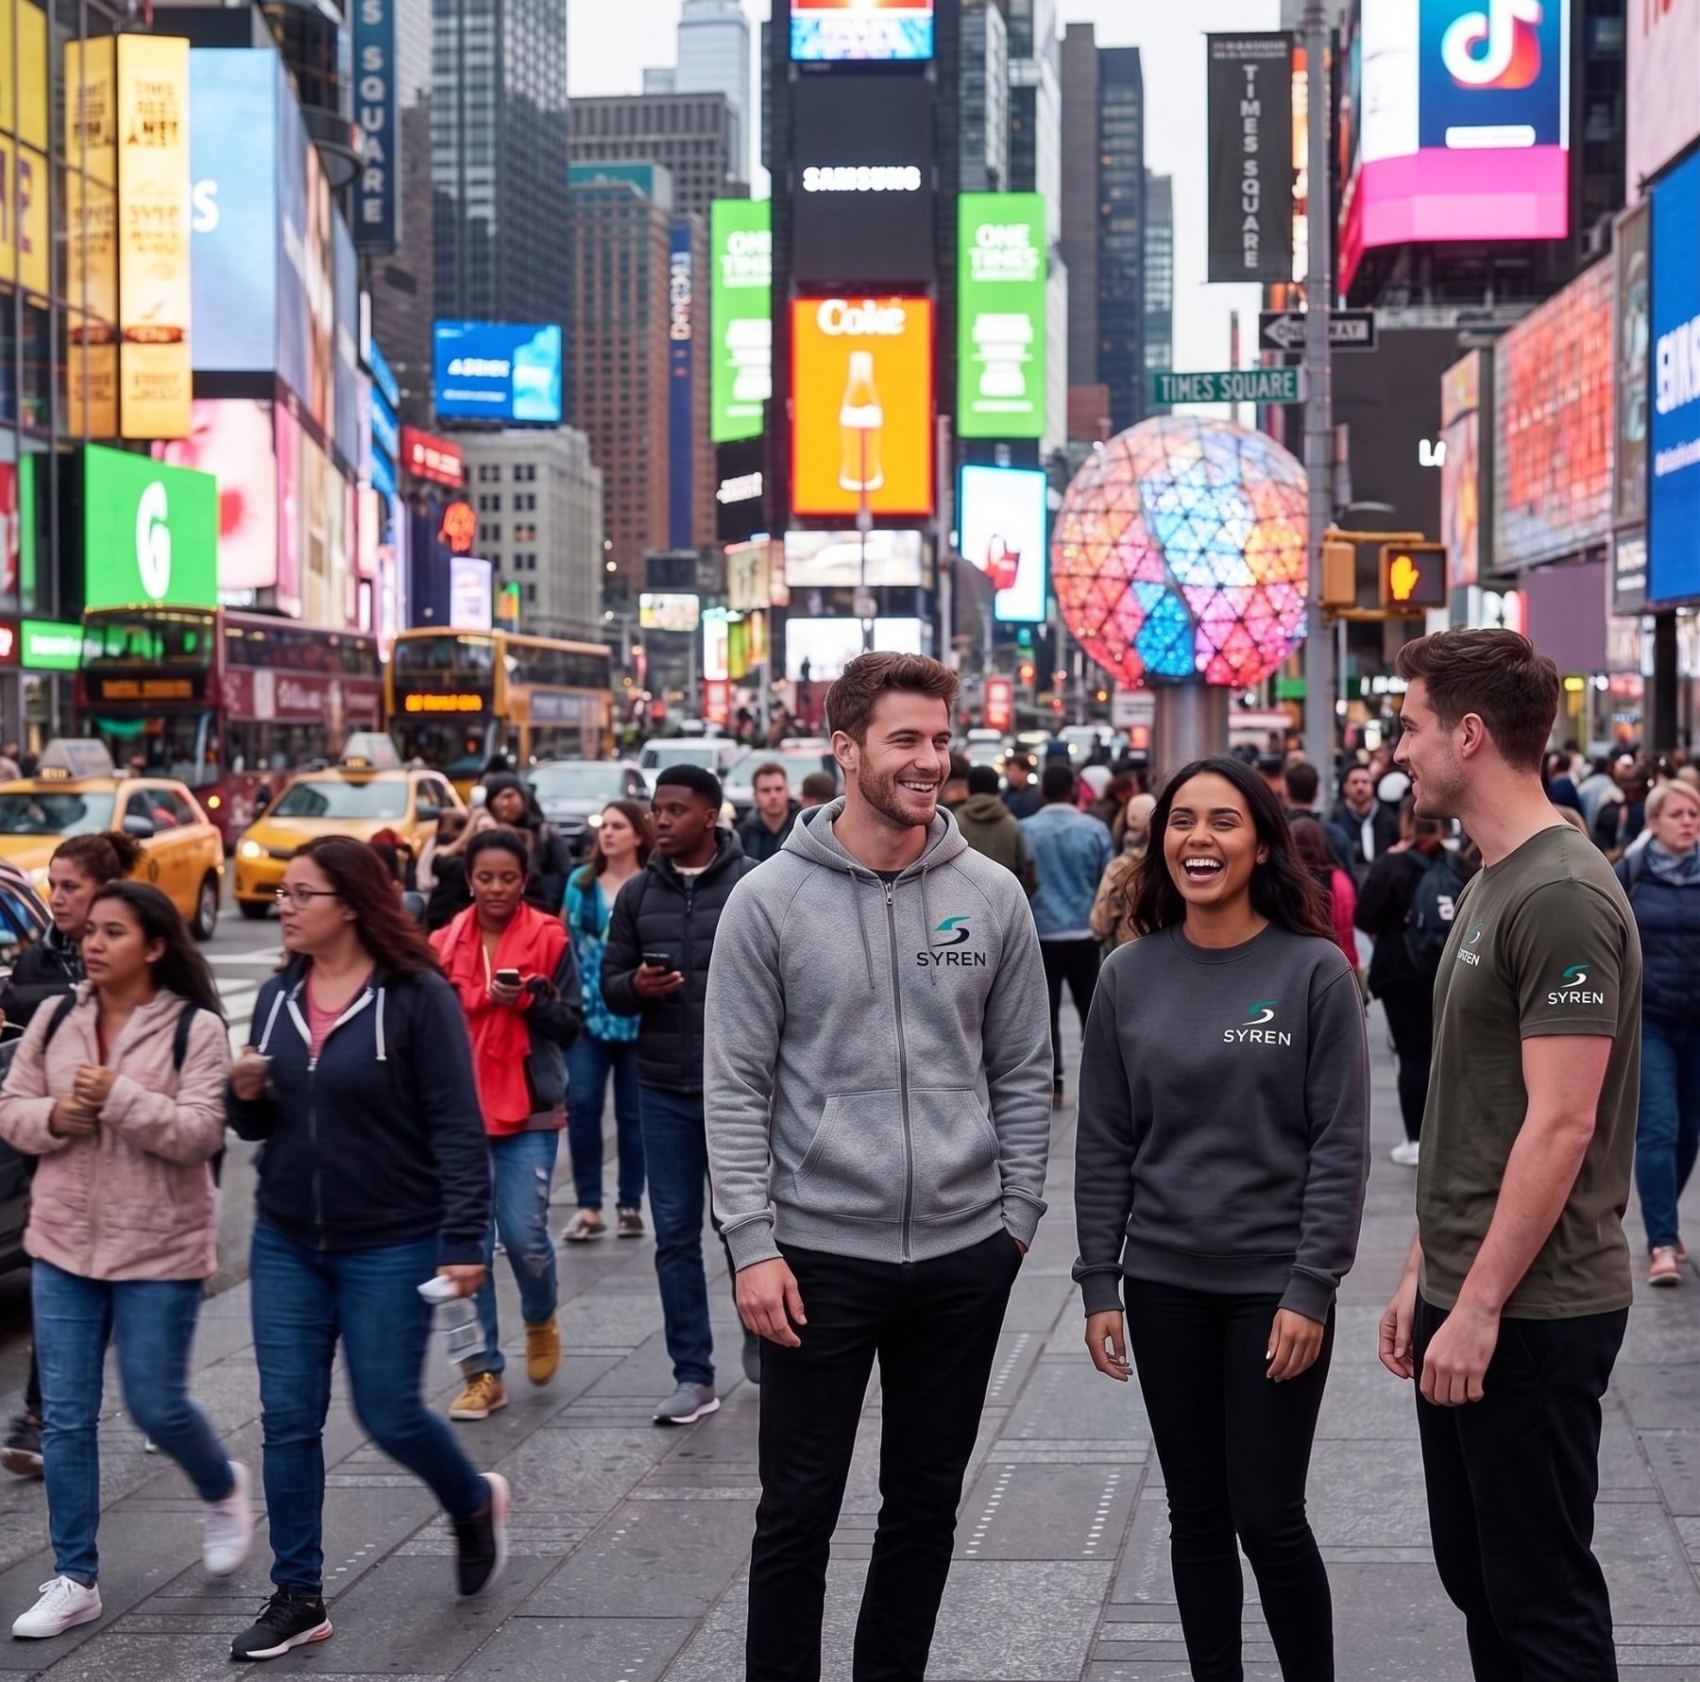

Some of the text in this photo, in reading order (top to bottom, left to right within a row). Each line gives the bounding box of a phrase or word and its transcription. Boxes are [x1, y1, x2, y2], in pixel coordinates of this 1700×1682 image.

[360, 45, 385, 223] SQUARE
[803, 166, 921, 192] SAMSUNG
[1240, 64, 1261, 268] TIMES SQUARE
[817, 298, 906, 336] Coke
[1161, 371, 1295, 401] TIMES SQUARE
[916, 951, 986, 967] SYREN
[1548, 991, 1604, 1005] SYREN
[1223, 1029, 1292, 1047] SYREN
